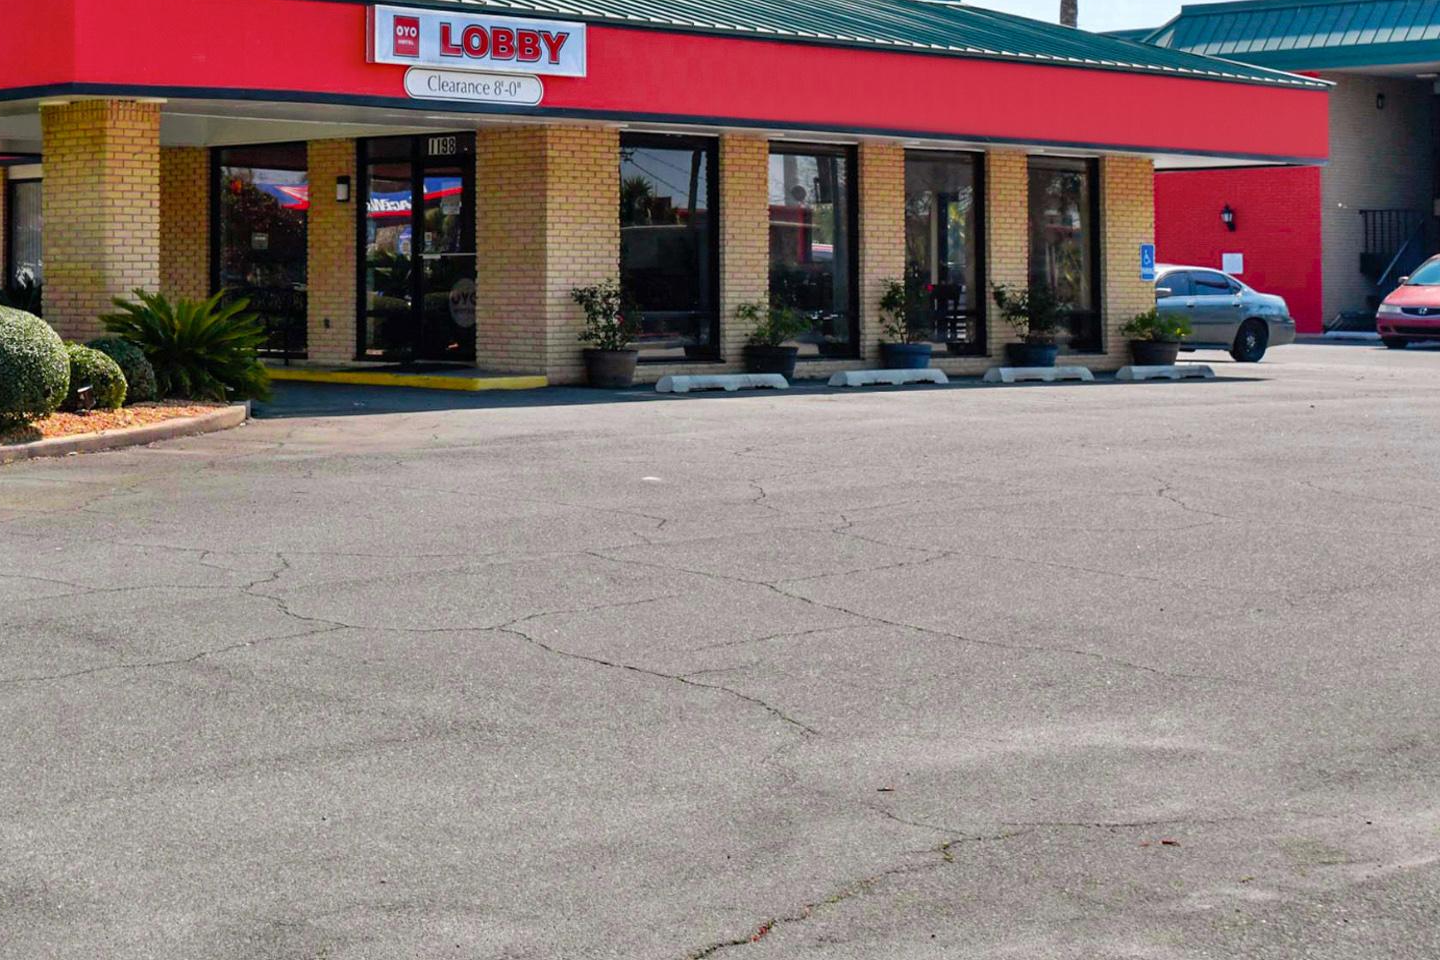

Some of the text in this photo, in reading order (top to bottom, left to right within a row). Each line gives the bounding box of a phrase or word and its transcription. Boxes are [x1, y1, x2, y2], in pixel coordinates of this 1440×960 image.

[396, 25, 417, 38] OYO
[439, 21, 570, 65] LOBBY
[427, 74, 490, 96] Clearance
[428, 136, 456, 156] 1198
